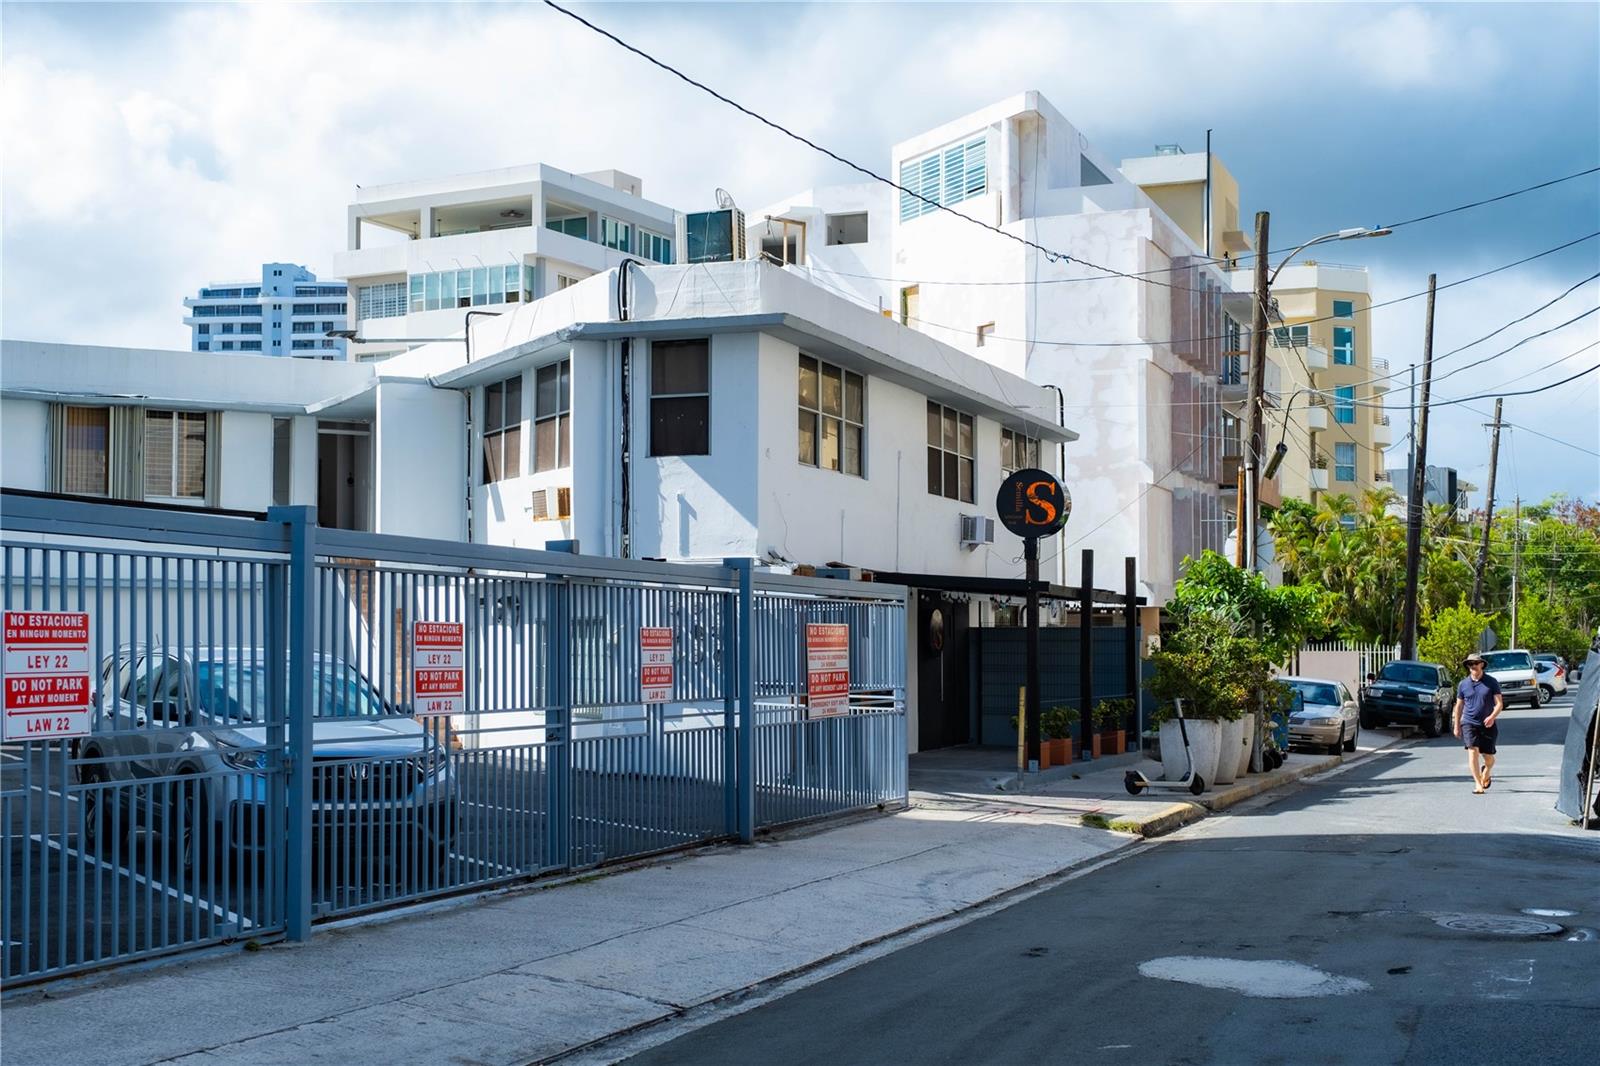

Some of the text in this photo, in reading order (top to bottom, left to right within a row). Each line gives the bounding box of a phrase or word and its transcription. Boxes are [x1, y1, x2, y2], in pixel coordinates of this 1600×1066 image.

[1026, 481, 1056, 525] S
[10, 615, 83, 627] NO ESTACIONE
[7, 629, 87, 638] EN NINGUN MOMENTO
[418, 624, 460, 634] NO ESTACIONE
[809, 627, 845, 636] NO ESTACIONE
[28, 655, 68, 669] LEY 22
[428, 654, 451, 664] LEY 22
[649, 654, 658, 662] LEY
[420, 672, 460, 680] DO NOT PARK
[812, 673, 845, 683] DO NOT PARK
[12, 678, 83, 692] DO NOT PARK
[16, 693, 79, 704] AT ANY MOMENT
[649, 691, 665, 700] LAW 22
[427, 700, 452, 711] LAW 22
[27, 717, 70, 732] LAW 22
